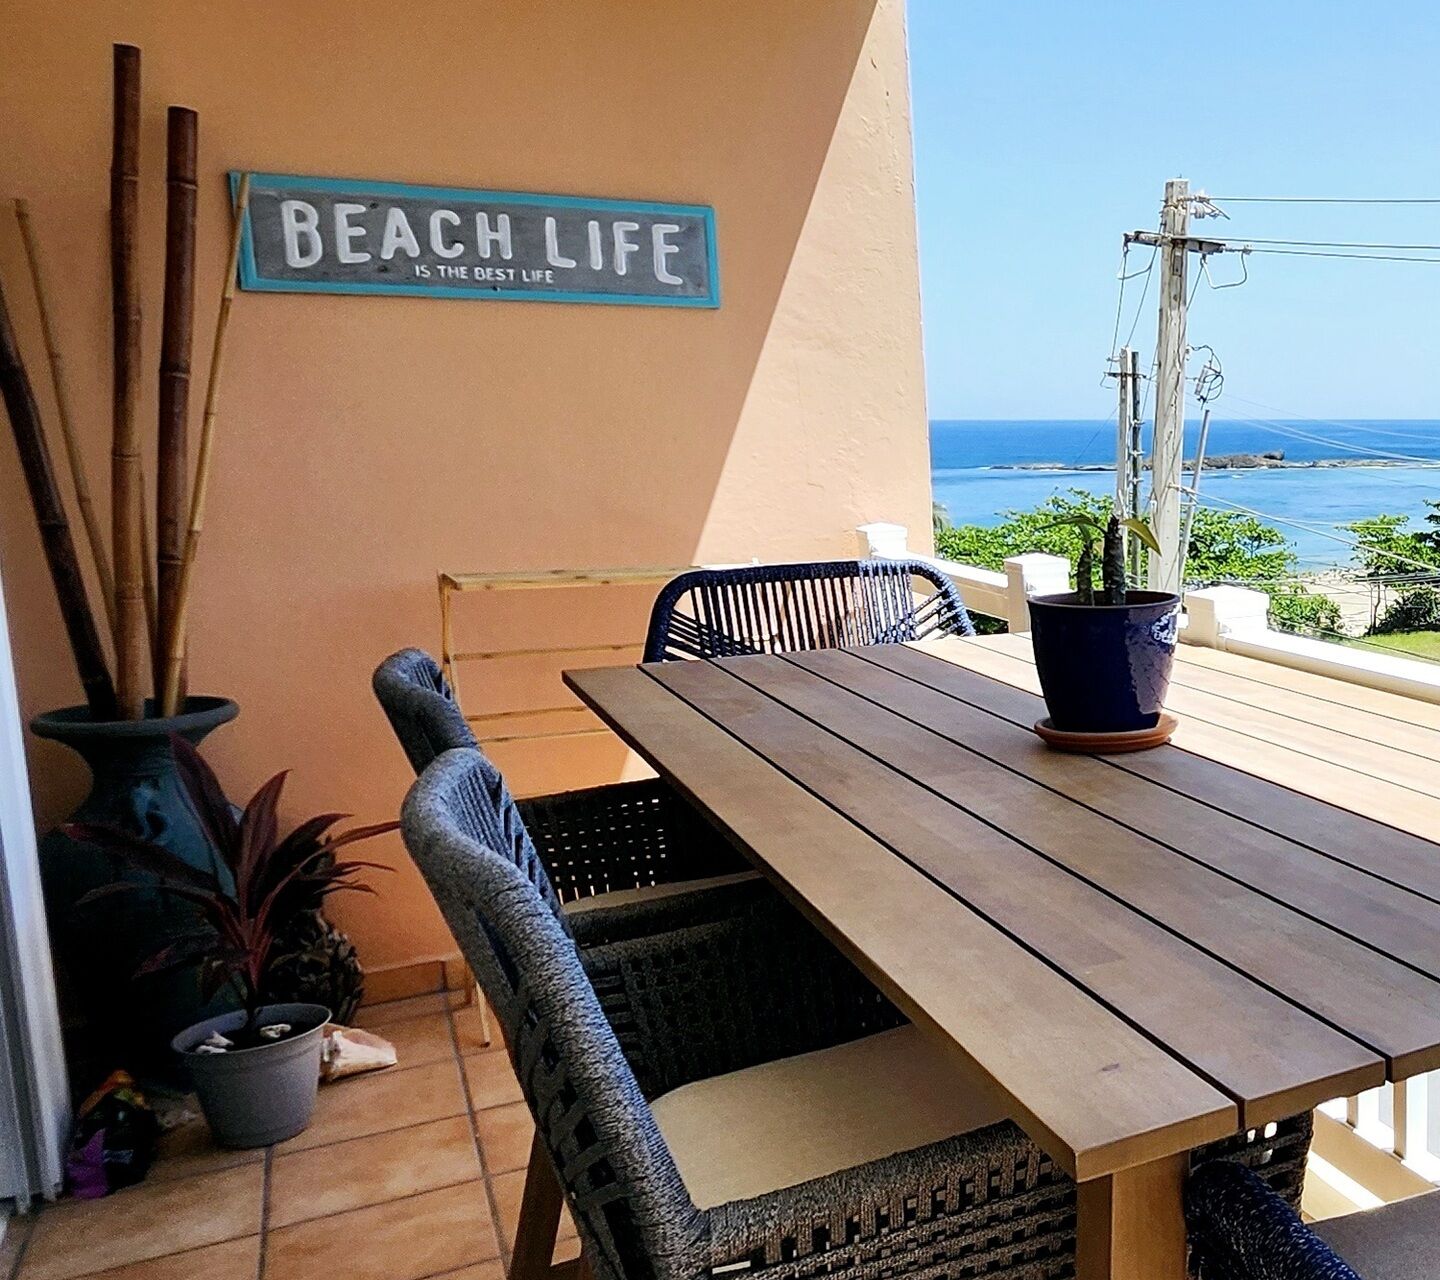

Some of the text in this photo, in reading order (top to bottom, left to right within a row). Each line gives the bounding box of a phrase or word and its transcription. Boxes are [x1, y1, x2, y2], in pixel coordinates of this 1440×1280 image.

[280, 200, 684, 285] BEACH LIFE
[414, 264, 554, 284] IS THE BEST LIFE
